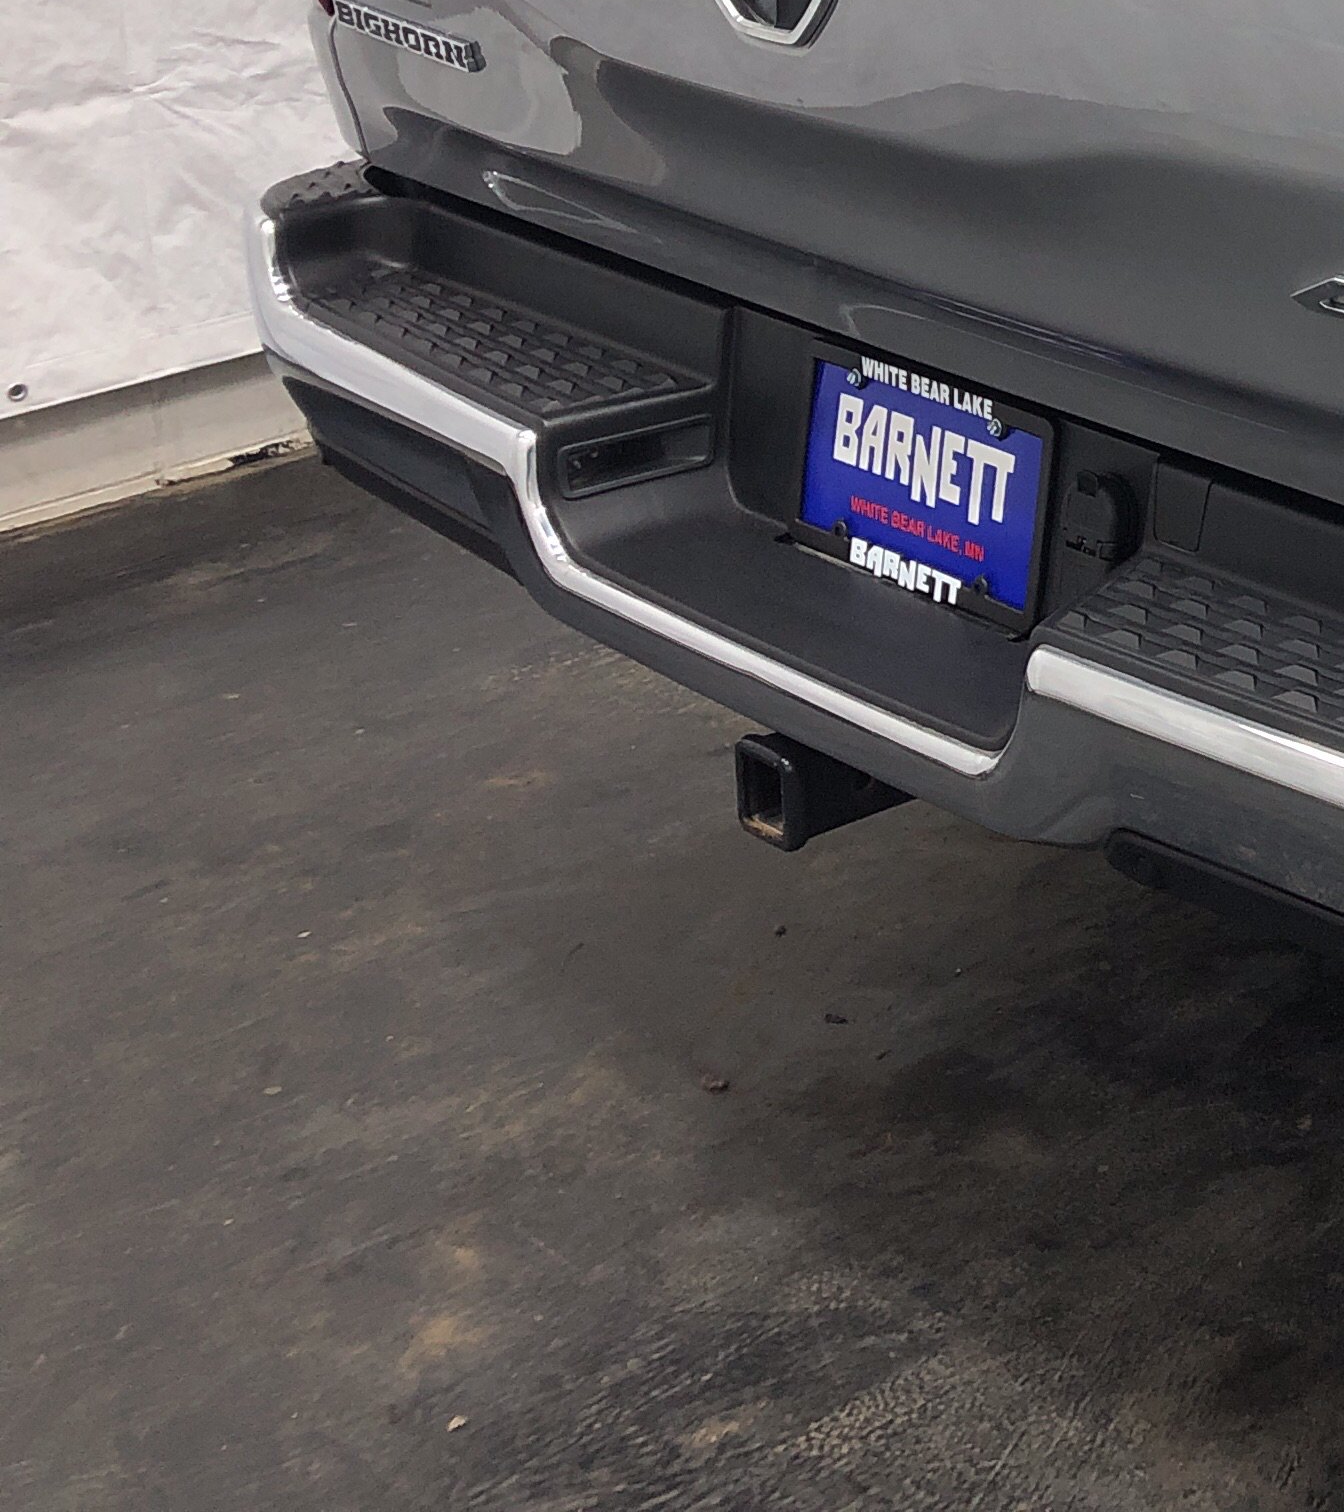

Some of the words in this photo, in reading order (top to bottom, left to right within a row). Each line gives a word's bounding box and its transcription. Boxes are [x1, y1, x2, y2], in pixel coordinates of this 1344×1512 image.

[861, 356, 908, 392] WHITE
[910, 373, 951, 406] BEAR
[953, 388, 994, 421] LAKE
[832, 392, 1016, 526] BARNETT
[850, 495, 889, 525] WHITE
[891, 511, 925, 538] BEAR
[927, 525, 962, 556] LAKE,
[963, 541, 985, 562] MN
[849, 536, 962, 605] BARNETT
